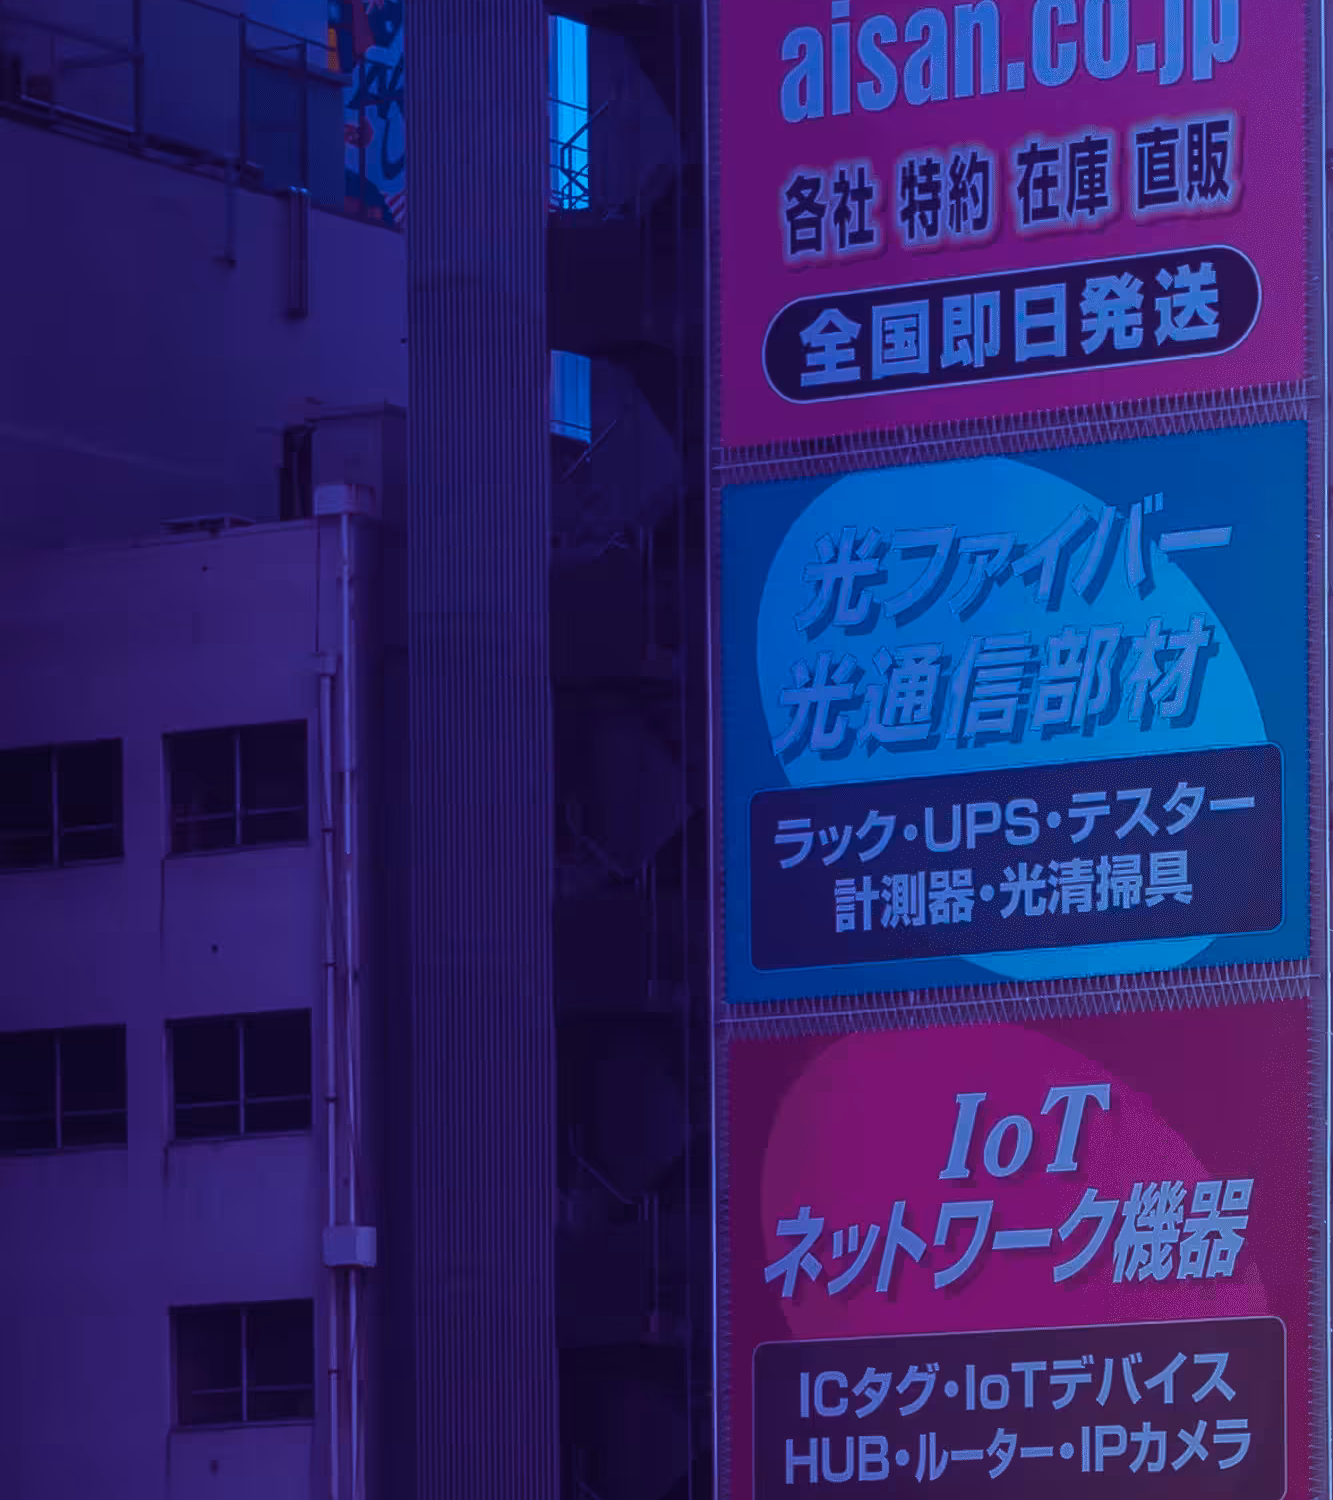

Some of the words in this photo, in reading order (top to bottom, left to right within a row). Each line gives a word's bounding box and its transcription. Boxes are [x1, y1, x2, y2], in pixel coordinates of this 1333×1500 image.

[785, 166, 874, 257] 各社
[900, 150, 990, 242] 特約
[1016, 136, 1110, 226] 在庫
[1135, 119, 1231, 210] 直販
[800, 263, 1219, 387] 全国即日発送
[795, 493, 1232, 632] 光ファイバー
[772, 614, 1216, 757] 光通信部材
[774, 782, 1255, 869] ラック・UPS・テスター
[835, 850, 1193, 932] 計測器・光清掃具
[939, 1083, 1111, 1180] IoT
[764, 1178, 1254, 1298] ネットワーク機器
[800, 1352, 1237, 1418] ICタグ・IoTデバイス
[785, 1418, 1252, 1485] HUB・ルーター・IPカメラ
